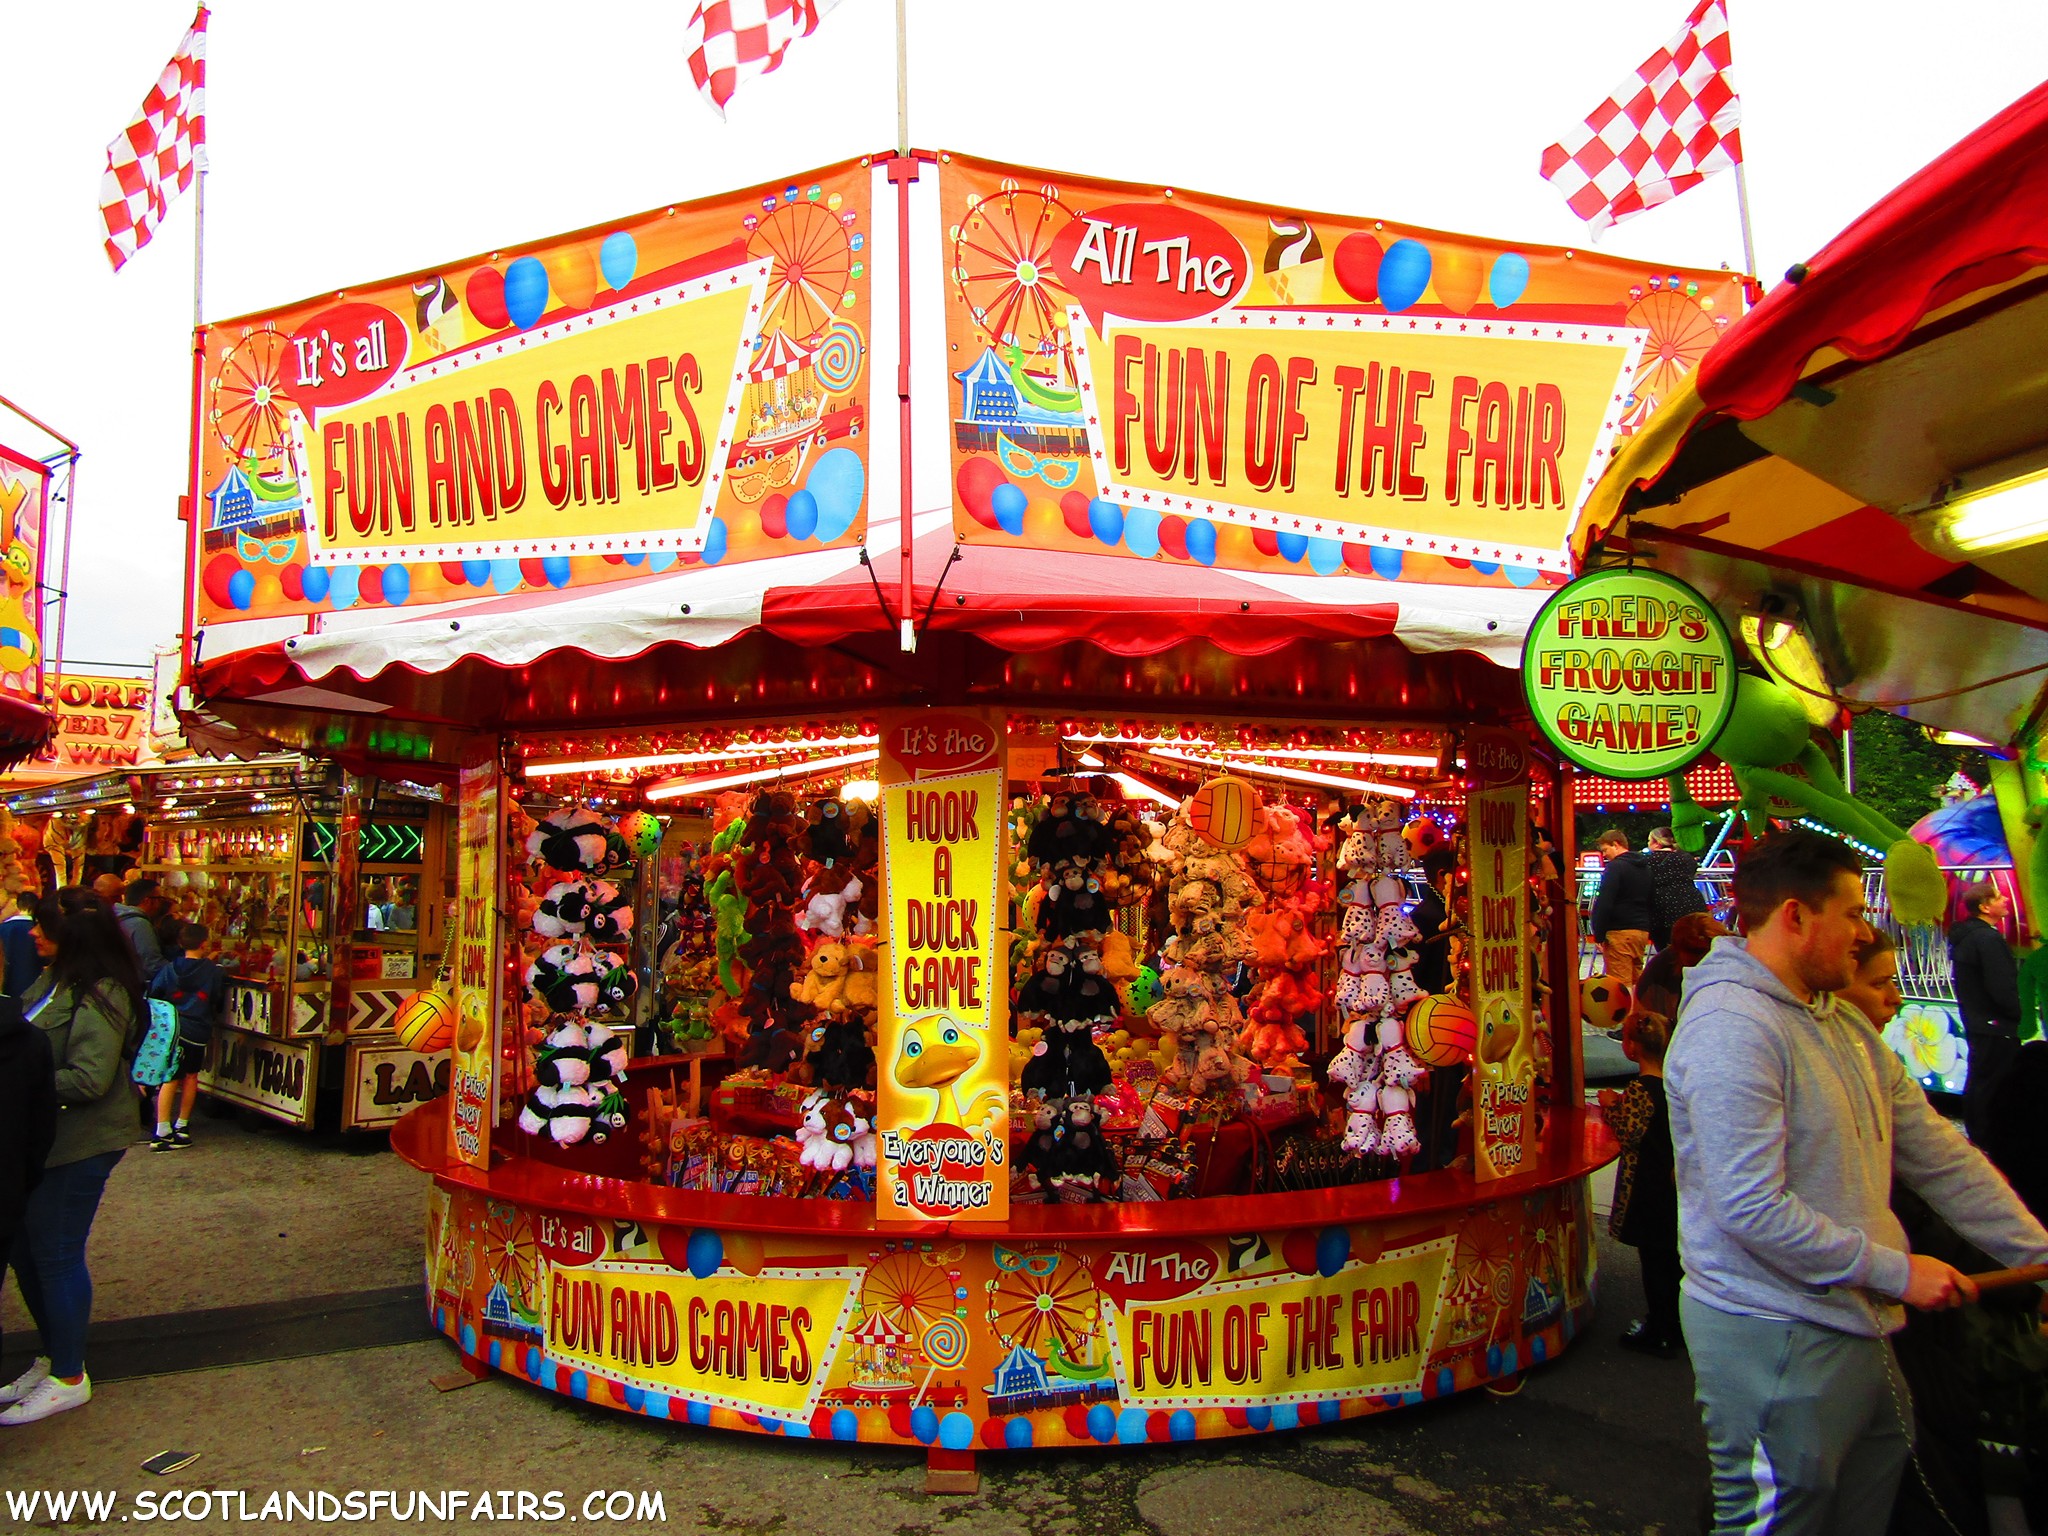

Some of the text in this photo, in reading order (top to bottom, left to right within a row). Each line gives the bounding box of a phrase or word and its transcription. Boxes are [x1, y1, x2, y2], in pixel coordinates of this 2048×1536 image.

[1071, 217, 1235, 297] All The
[294, 318, 389, 387] It's all
[1113, 334, 1567, 511] FUN OF THE FAIR
[323, 353, 706, 542] FUN AND GAMES
[1557, 595, 1709, 642] FRED'S
[1540, 648, 1724, 695] FROGGIT
[109, 714, 134, 740] 7
[901, 725, 986, 755] It's the
[1557, 702, 1700, 754] GAME!
[65, 742, 138, 766] WIN
[1477, 743, 1518, 771] It's the
[906, 789, 980, 844] HOOK
[1480, 798, 1517, 848] HOOK
[934, 845, 953, 898] A
[1494, 849, 1504, 895] A
[464, 895, 487, 941] DUCK
[907, 898, 979, 950] DUCK
[1481, 895, 1517, 943] DUCK
[462, 943, 487, 990] GAME
[904, 956, 982, 1010] GAME
[1482, 946, 1519, 993] GAME
[253, 1047, 304, 1101] VEGAS
[464, 1072, 488, 1101] Prize
[1480, 1079, 1529, 1110] A Prize
[457, 1094, 482, 1135] Every
[1485, 1110, 1522, 1141] Every
[881, 1130, 1003, 1171] Everyone's
[1488, 1142, 1523, 1167] Time
[894, 1173, 992, 1209] a Winner
[539, 1216, 593, 1254] It's all
[1105, 1252, 1210, 1284] All The
[550, 1272, 812, 1386] FUN AND GAMES
[1132, 1281, 1421, 1392] FUN OF THE FAIR
